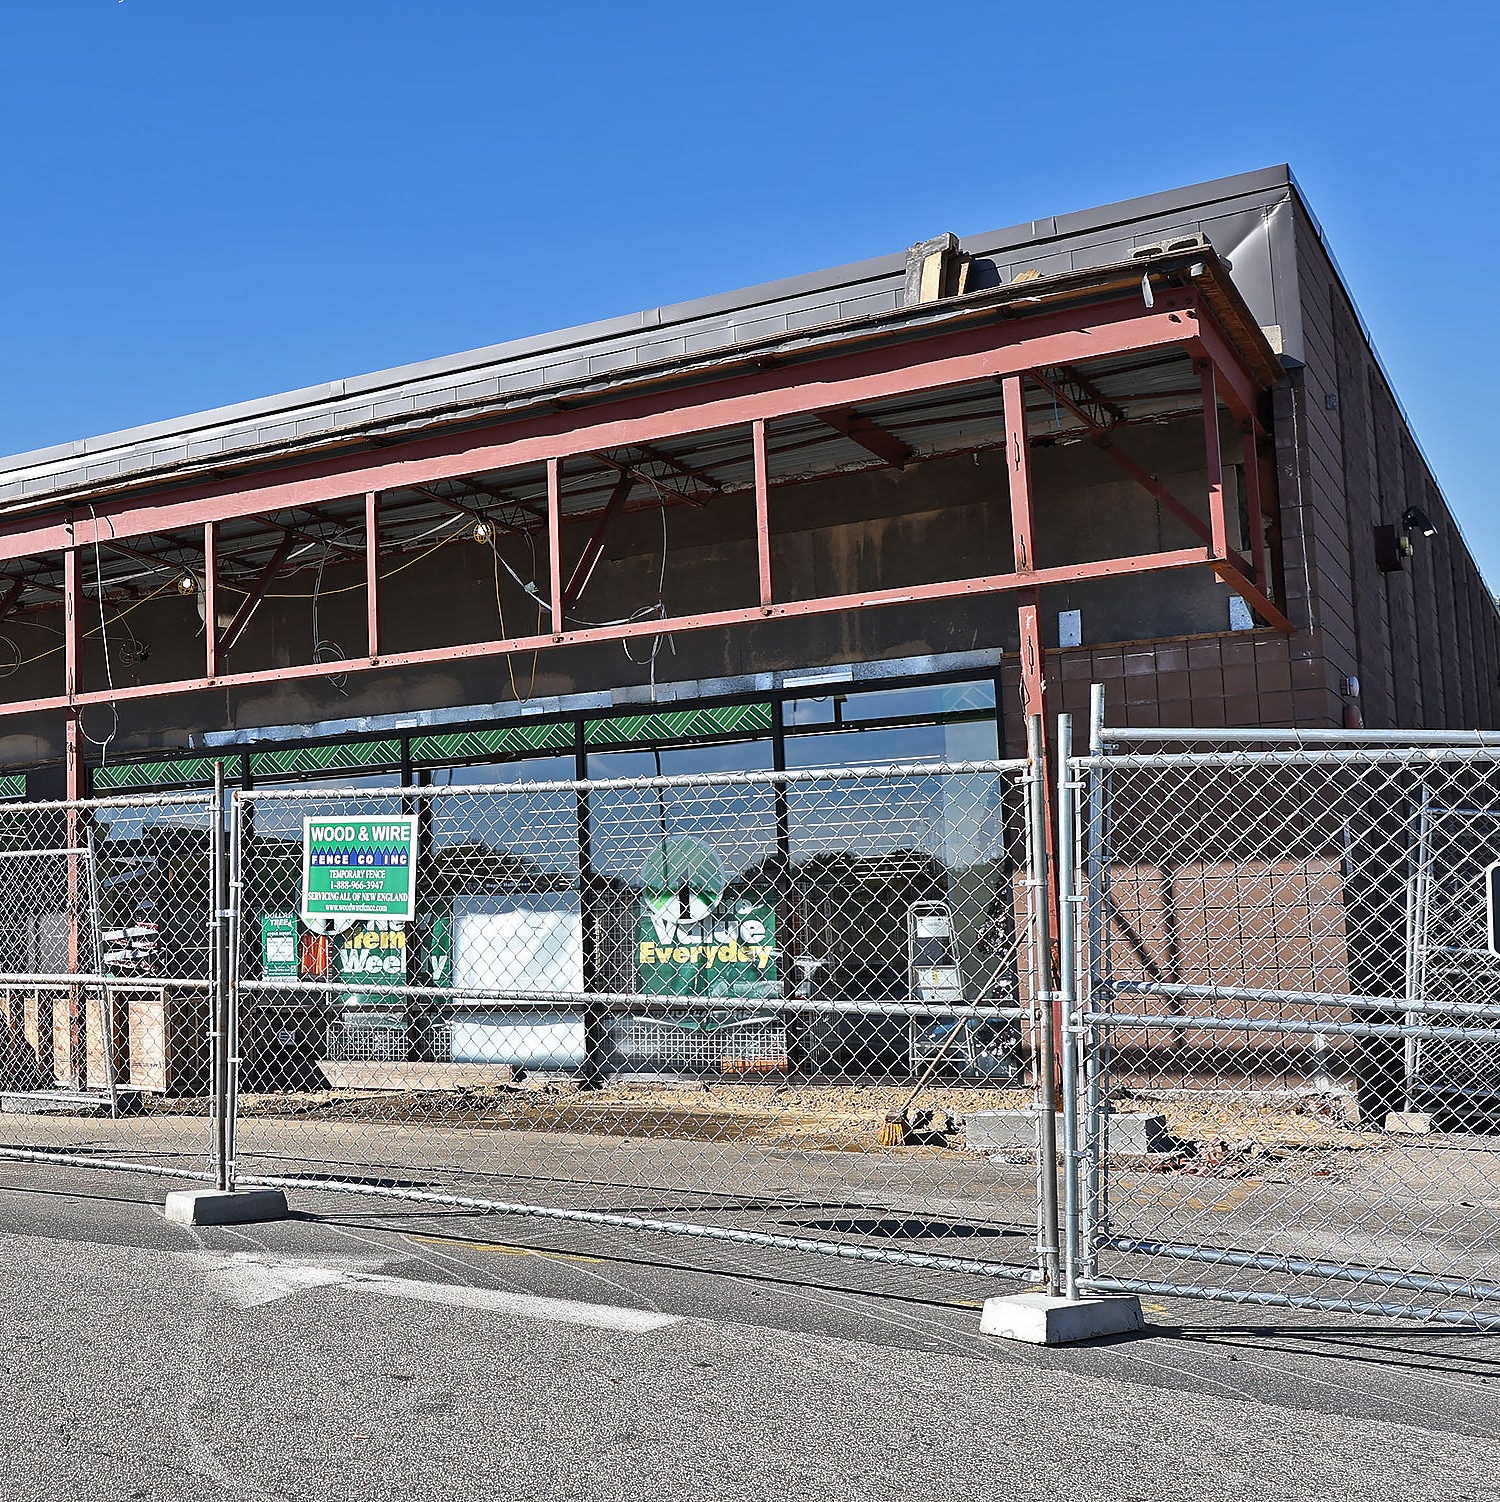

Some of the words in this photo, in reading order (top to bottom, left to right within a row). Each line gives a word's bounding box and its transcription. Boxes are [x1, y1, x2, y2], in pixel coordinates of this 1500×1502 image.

[311, 825, 356, 842] WOOD
[358, 825, 370, 842] &
[371, 825, 411, 842] WIRE
[311, 854, 350, 865] FENCE
[357, 854, 374, 865] CO
[383, 854, 408, 865] INC
[329, 869, 366, 879] TEMPORARY
[366, 869, 386, 879] FENCE
[330, 880, 385, 890] 1-888-966-3947
[308, 891, 339, 901] SERVICING
[339, 892, 352, 902] ALL
[352, 892, 361, 902] OF
[362, 892, 377, 902] NEW
[377, 892, 408, 902] ENGLAND
[650, 913, 767, 945] Value
[639, 940, 773, 969] Everyday
